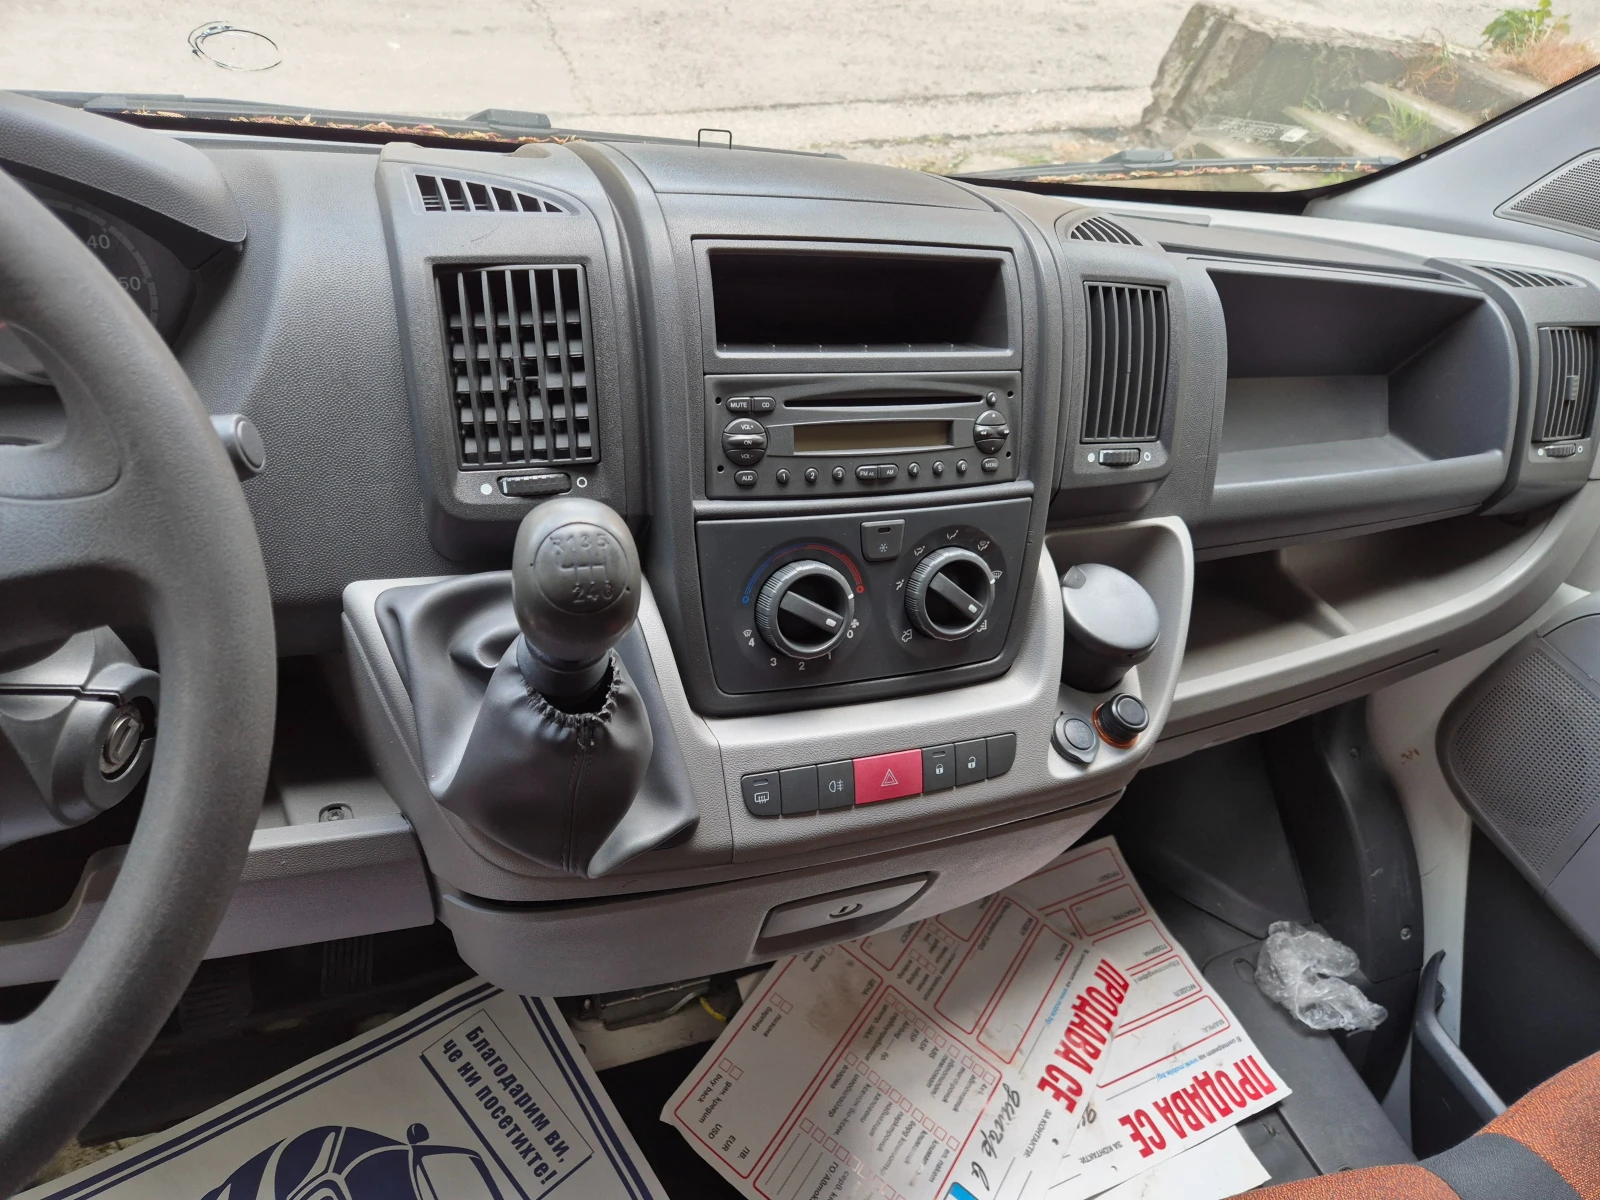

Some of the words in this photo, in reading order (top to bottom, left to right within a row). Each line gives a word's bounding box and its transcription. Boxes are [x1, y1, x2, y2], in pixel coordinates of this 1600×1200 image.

[86, 234, 111, 250] 40
[937, 465, 942, 473] 5
[748, 639, 755, 647] 4
[847, 630, 854, 639] 0
[770, 657, 777, 666] 3
[798, 661, 805, 671] 2
[749, 1005, 773, 1032] бартер
[761, 1012, 782, 1038] лизинг
[1053, 958, 1129, 1075] ПРОДАВА
[907, 1027, 920, 1043] ESP
[916, 1036, 928, 1052] ASR
[1234, 1035, 1242, 1043] В
[926, 1044, 939, 1060] ABS
[465, 1026, 551, 1132] Благодарим
[707, 1072, 723, 1087] buy
[828, 1063, 850, 1090] аларма
[696, 1085, 713, 1104] back
[826, 1072, 861, 1119] имобилайзер
[1035, 1063, 1082, 1114] СЕ
[1151, 1054, 1277, 1140] ПРОДАВА
[443, 1039, 463, 1063] че
[457, 1061, 483, 1088] ни
[475, 1085, 558, 1185] посетихте!
[696, 1095, 722, 1125] кредит
[866, 1100, 894, 1138] навигация
[1042, 1107, 1052, 1120] ЗА
[706, 1121, 723, 1141] USD
[875, 1109, 905, 1153] парктроник
[900, 1119, 915, 1138] борд
[1021, 1117, 1047, 1159] КОНТАКТИ:
[1117, 1109, 1166, 1159] СЕ
[720, 1134, 736, 1153] EUR
[1111, 1139, 1123, 1150] ЗА
[1077, 1144, 1113, 1165] КОНТАКТИ:
[832, 1169, 851, 1192] серв.
[927, 1159, 945, 1184] пакет
